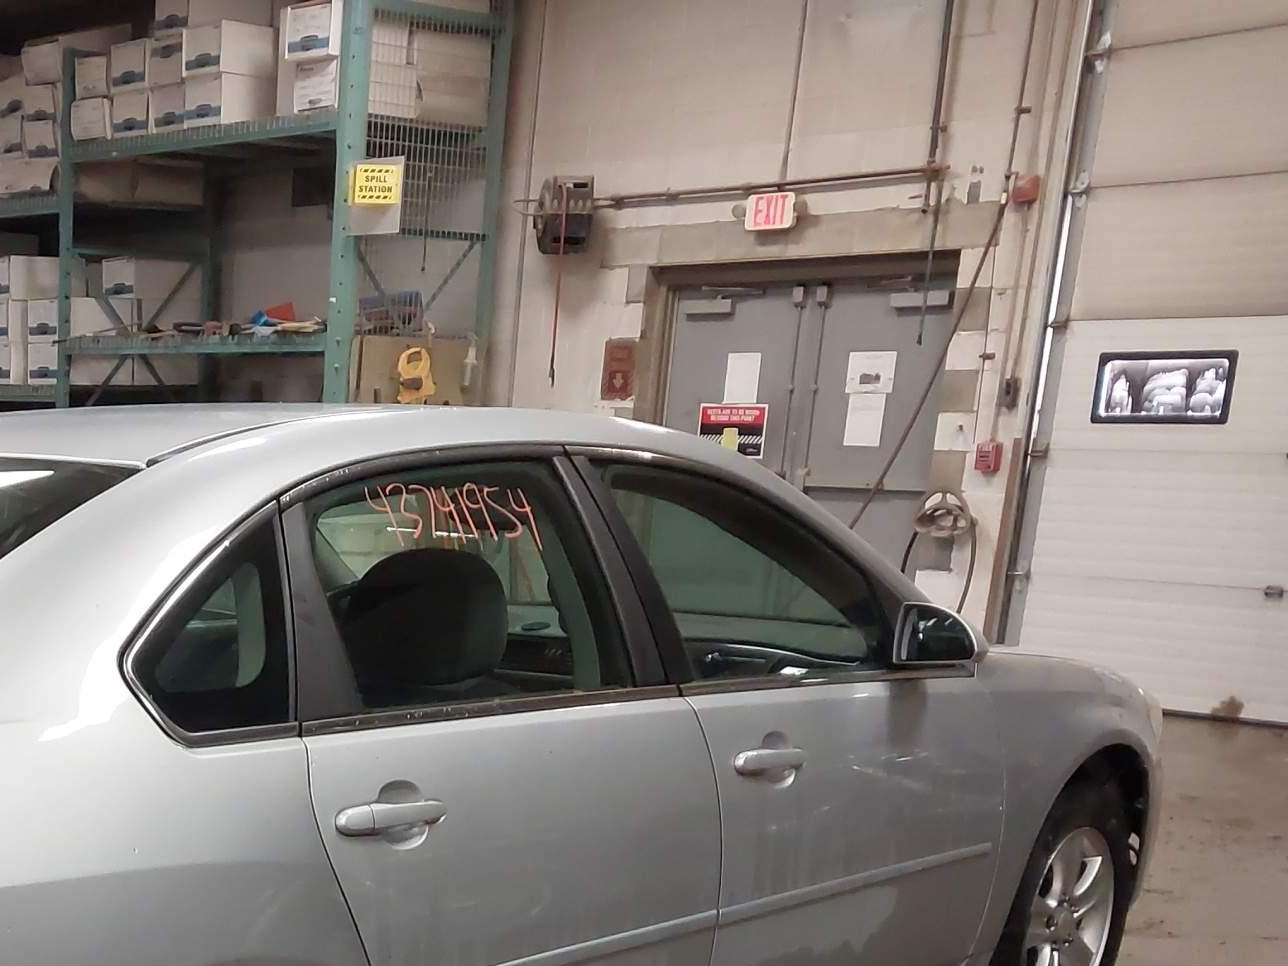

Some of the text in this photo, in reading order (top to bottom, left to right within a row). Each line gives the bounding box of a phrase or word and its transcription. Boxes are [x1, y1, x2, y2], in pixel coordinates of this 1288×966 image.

[358, 185, 393, 193] STATION
[364, 175, 388, 183] SPILL
[753, 194, 789, 226] EXIT
[364, 482, 544, 551] 43741954
